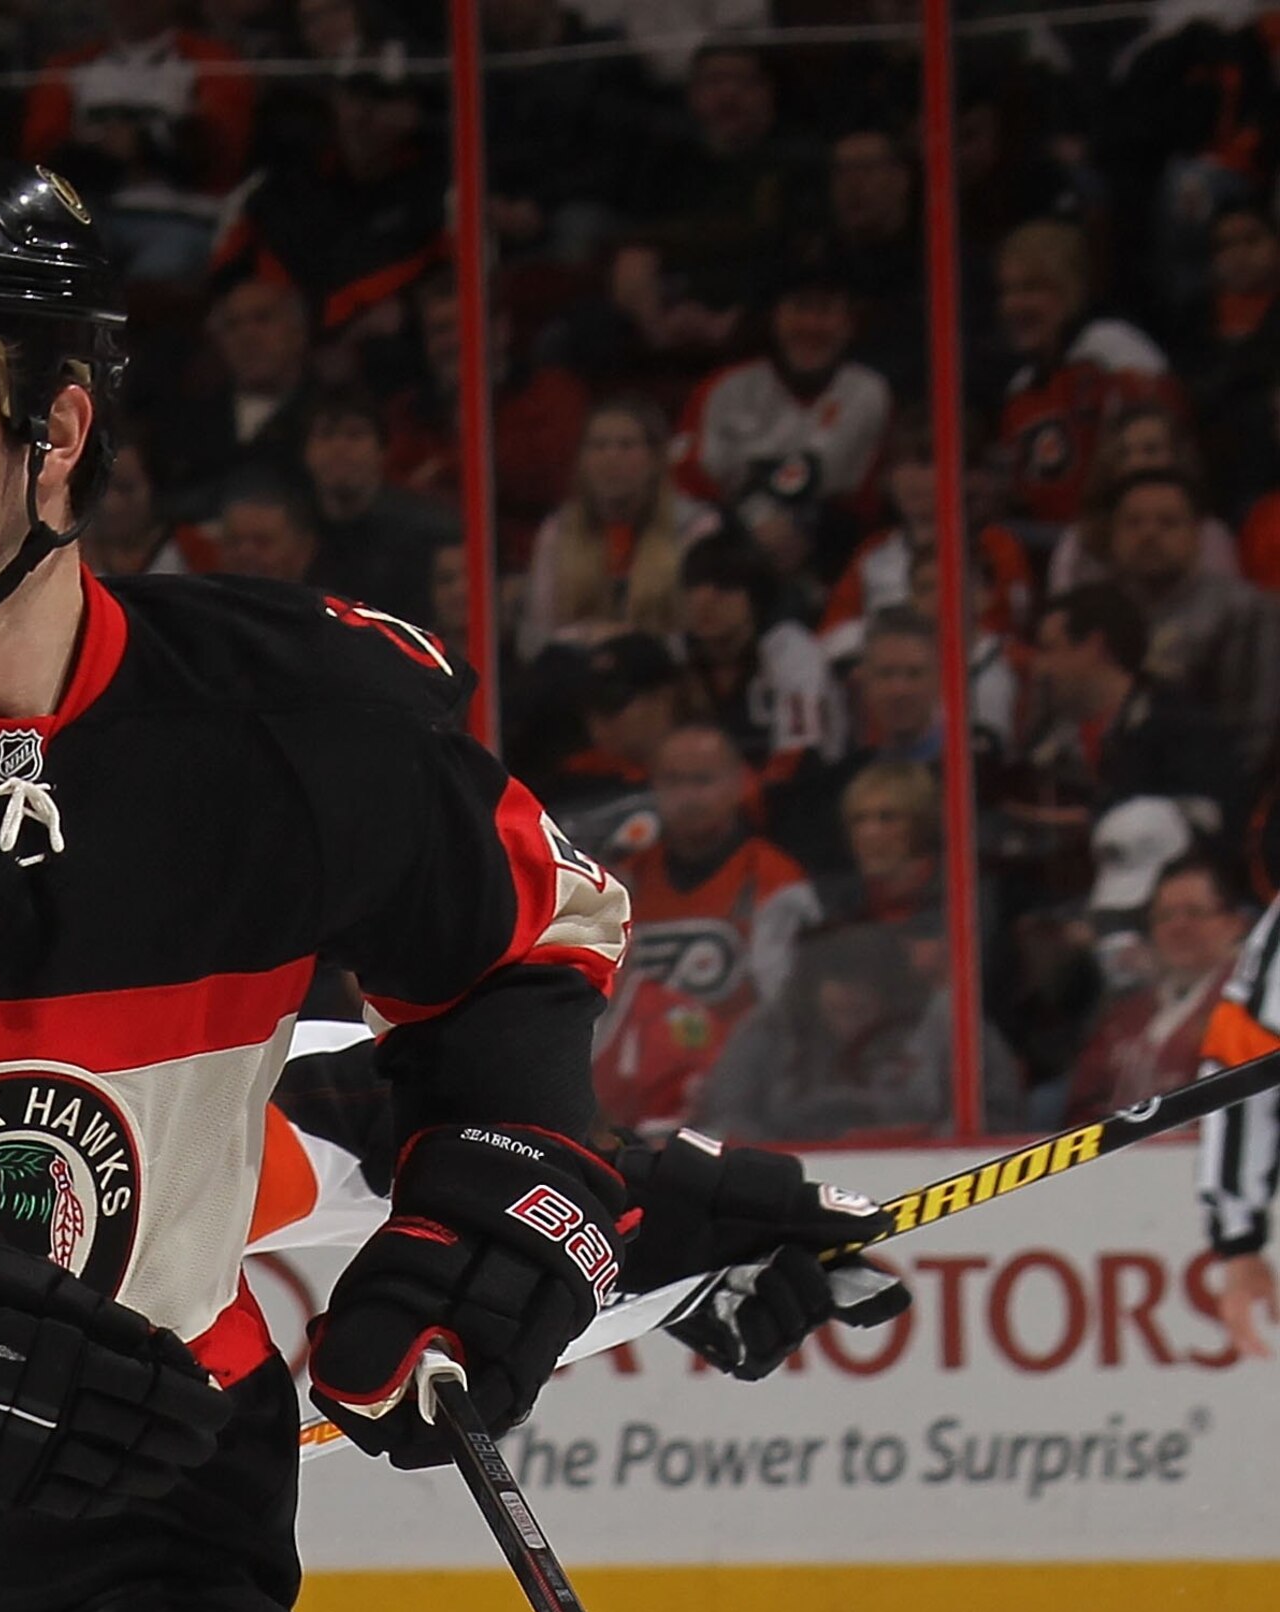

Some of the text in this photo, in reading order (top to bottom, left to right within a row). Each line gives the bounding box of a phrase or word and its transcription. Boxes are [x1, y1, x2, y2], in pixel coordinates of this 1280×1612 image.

[5, 743, 33, 774] NHL
[23, 1086, 132, 1217] HAWKS
[460, 1128, 545, 1161] SEABROOK
[690, 1243, 1241, 1377] OTORS
[518, 1428, 597, 1488] he
[618, 1420, 824, 1488] Power
[838, 1425, 909, 1487] to
